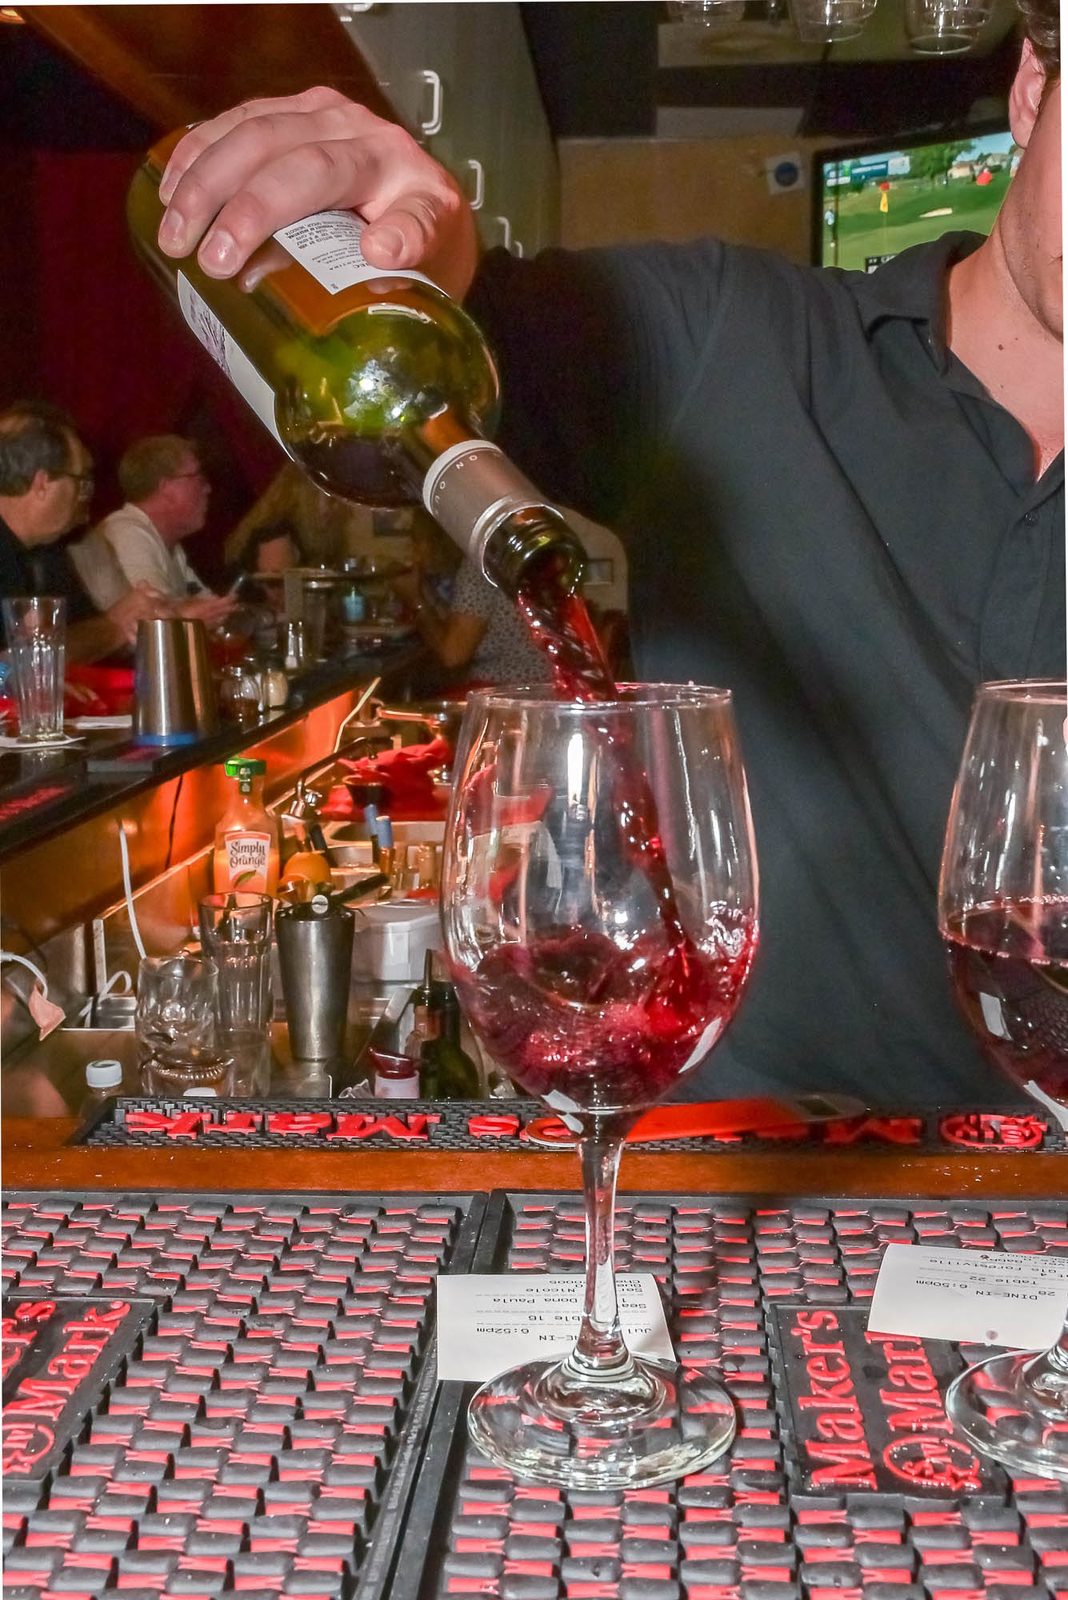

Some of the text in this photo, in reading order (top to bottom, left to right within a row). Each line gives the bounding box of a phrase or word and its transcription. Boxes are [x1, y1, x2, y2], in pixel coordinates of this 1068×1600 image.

[230, 840, 266, 856] Simply
[230, 855, 266, 868] Orange
[125, 1110, 442, 1141] Mark
[915, 1280, 968, 1289] 6:50pm
[995, 1277, 1039, 1286] Table
[975, 1290, 1038, 1300] DINE-IN
[554, 1314, 581, 1322] ble
[476, 1327, 530, 1335] 6:52pm
[2, 1300, 131, 1421] Mark
[790, 1310, 878, 1490] Maker's
